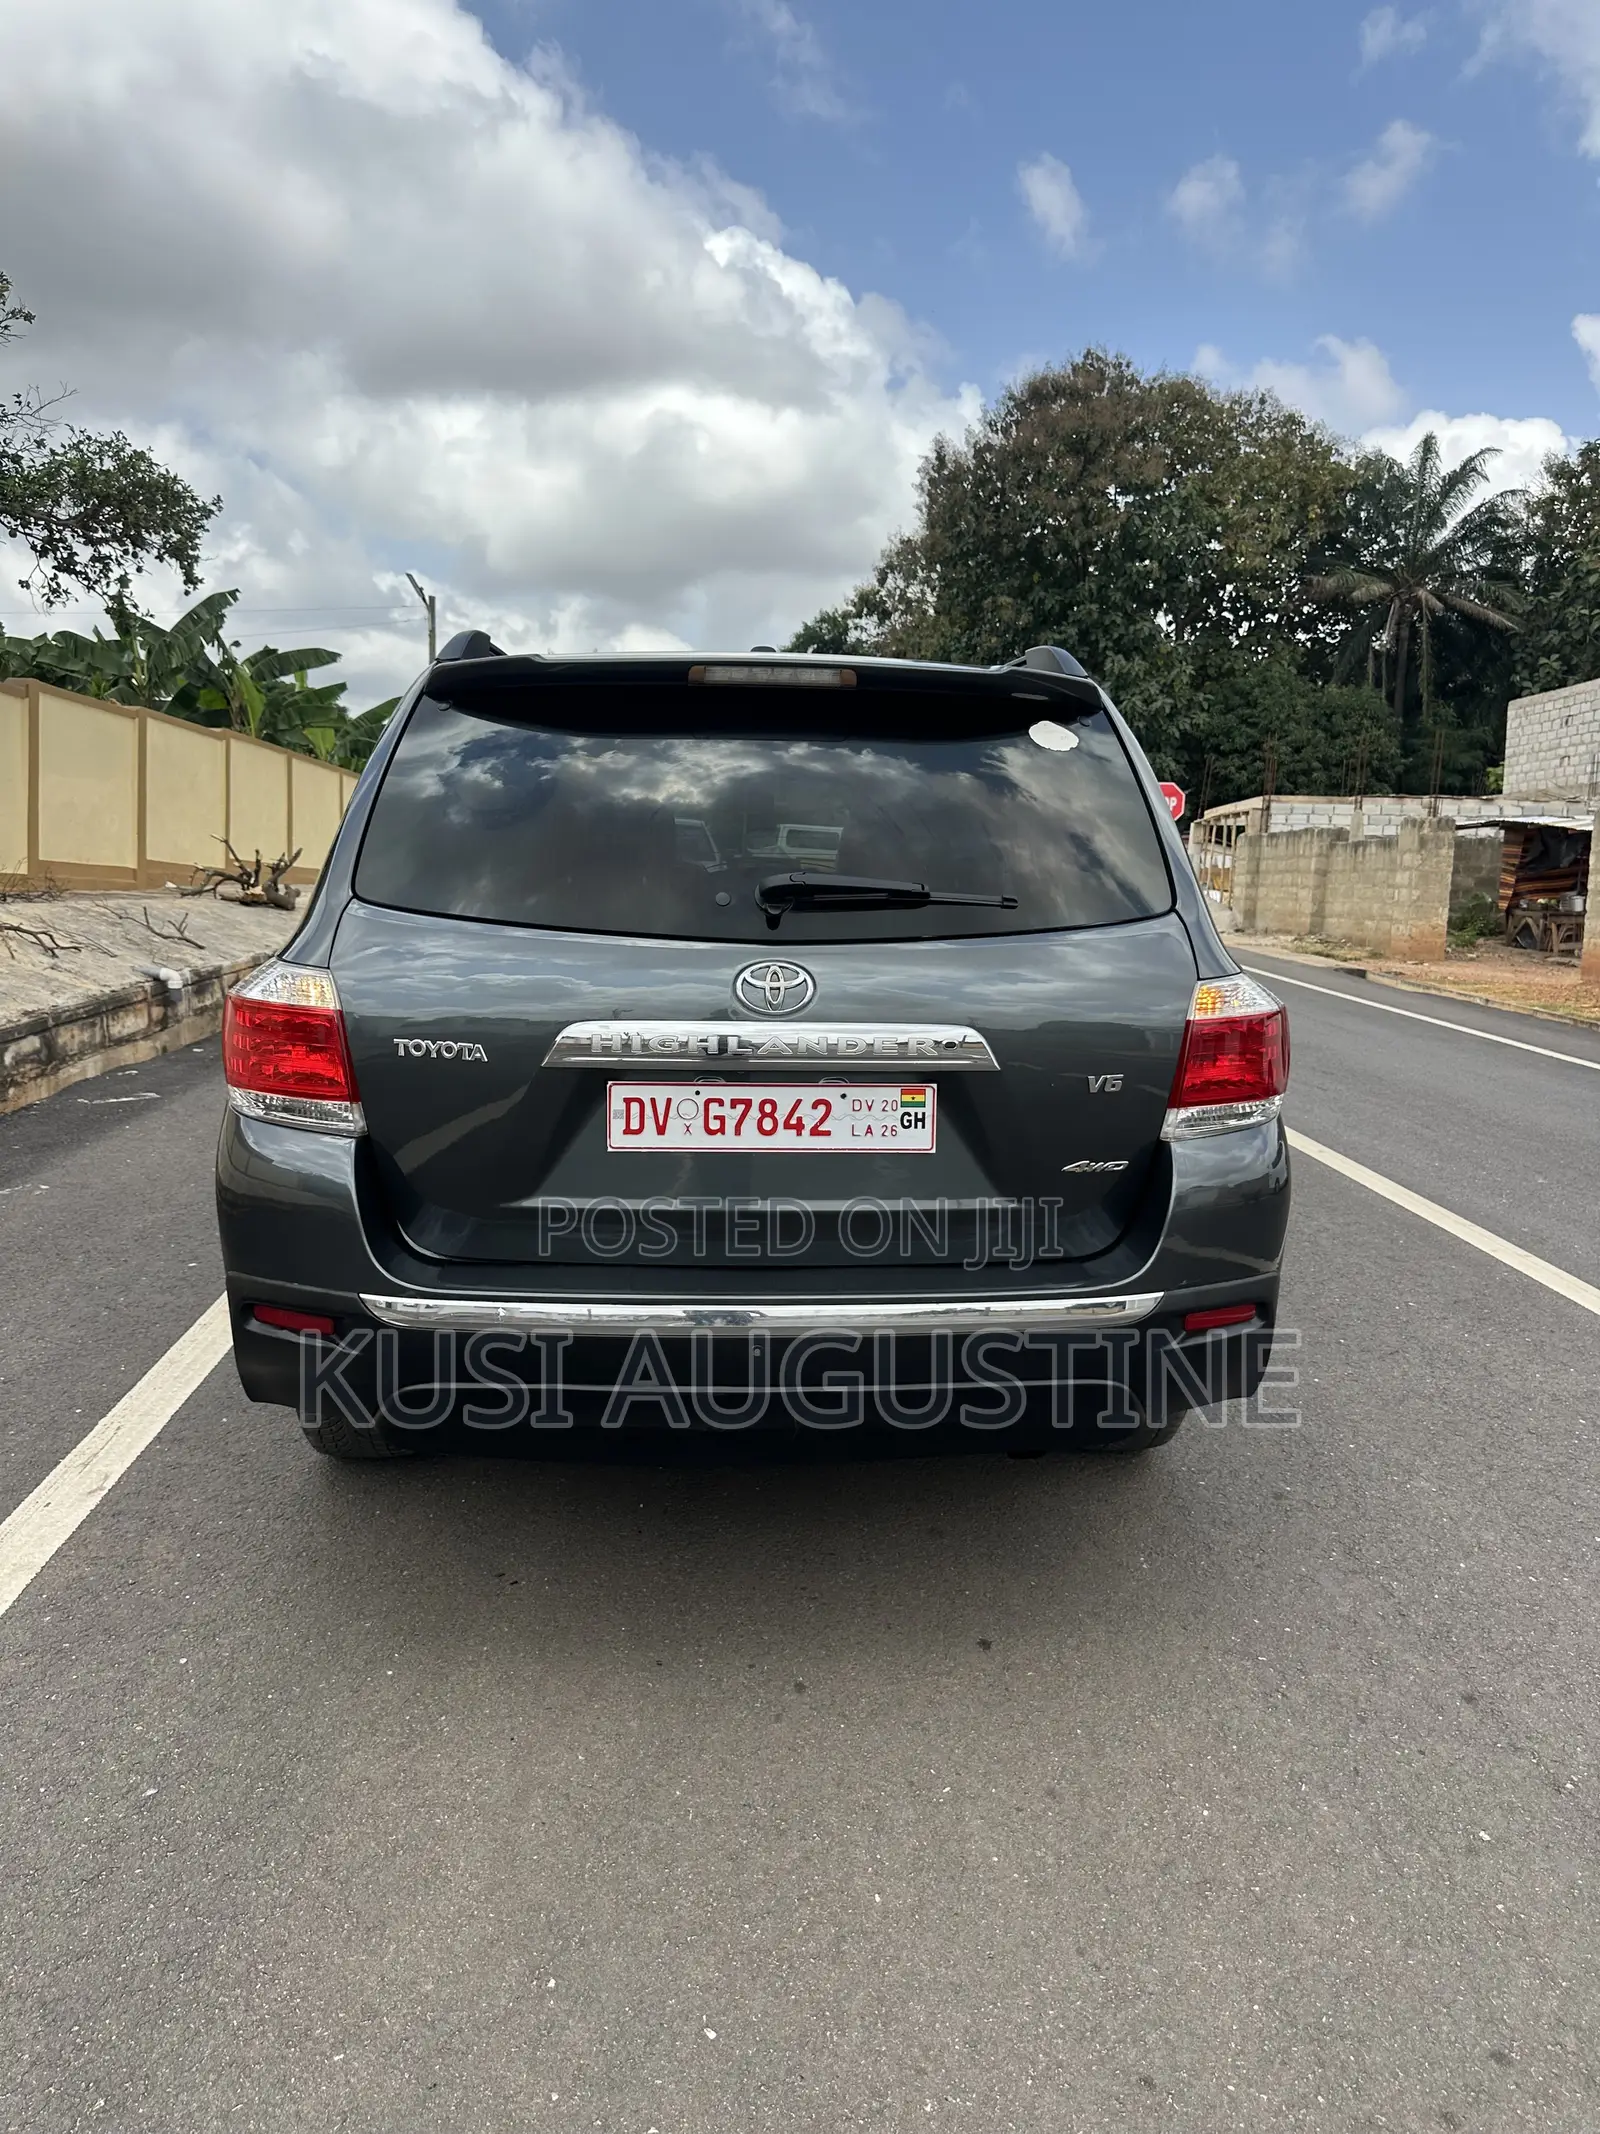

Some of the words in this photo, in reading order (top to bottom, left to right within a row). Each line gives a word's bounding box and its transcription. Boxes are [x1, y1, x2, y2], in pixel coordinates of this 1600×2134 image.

[393, 1038, 489, 1062] TOYOTA
[590, 1033, 939, 1056] HIGHLANDER
[1087, 1073, 1124, 1093] V6
[852, 1099, 875, 1112] DV
[881, 1099, 899, 1112] 20
[622, 1097, 673, 1136] DV
[703, 1097, 833, 1137] G7842
[900, 1111, 926, 1130] GH
[881, 1124, 898, 1137] 26
